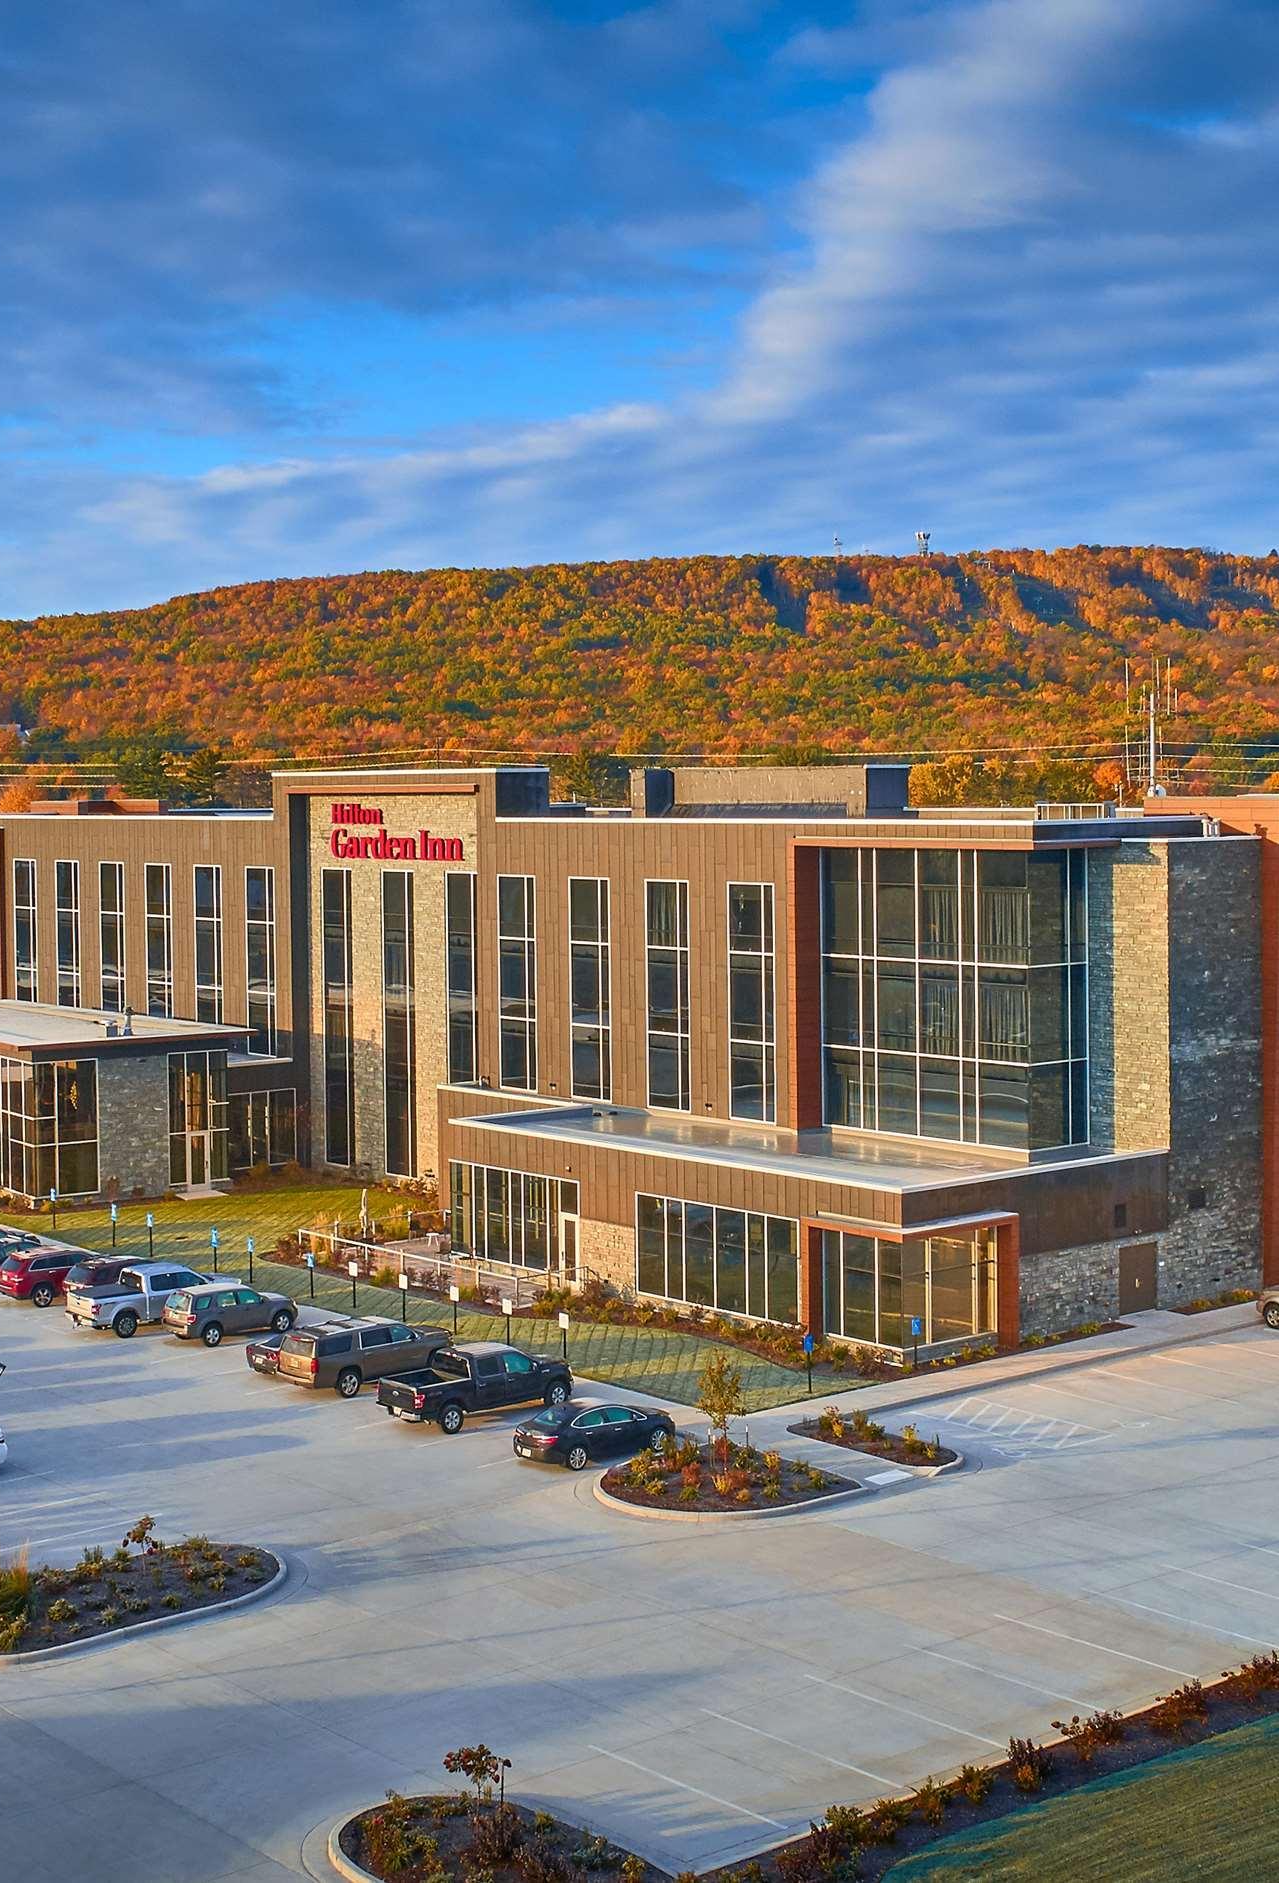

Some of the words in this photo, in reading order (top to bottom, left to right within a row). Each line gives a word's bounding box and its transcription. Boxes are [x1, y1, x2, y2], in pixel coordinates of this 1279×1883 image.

[331, 803, 383, 825] Hilton
[331, 828, 417, 859] Garden
[418, 829, 465, 861] Inn
